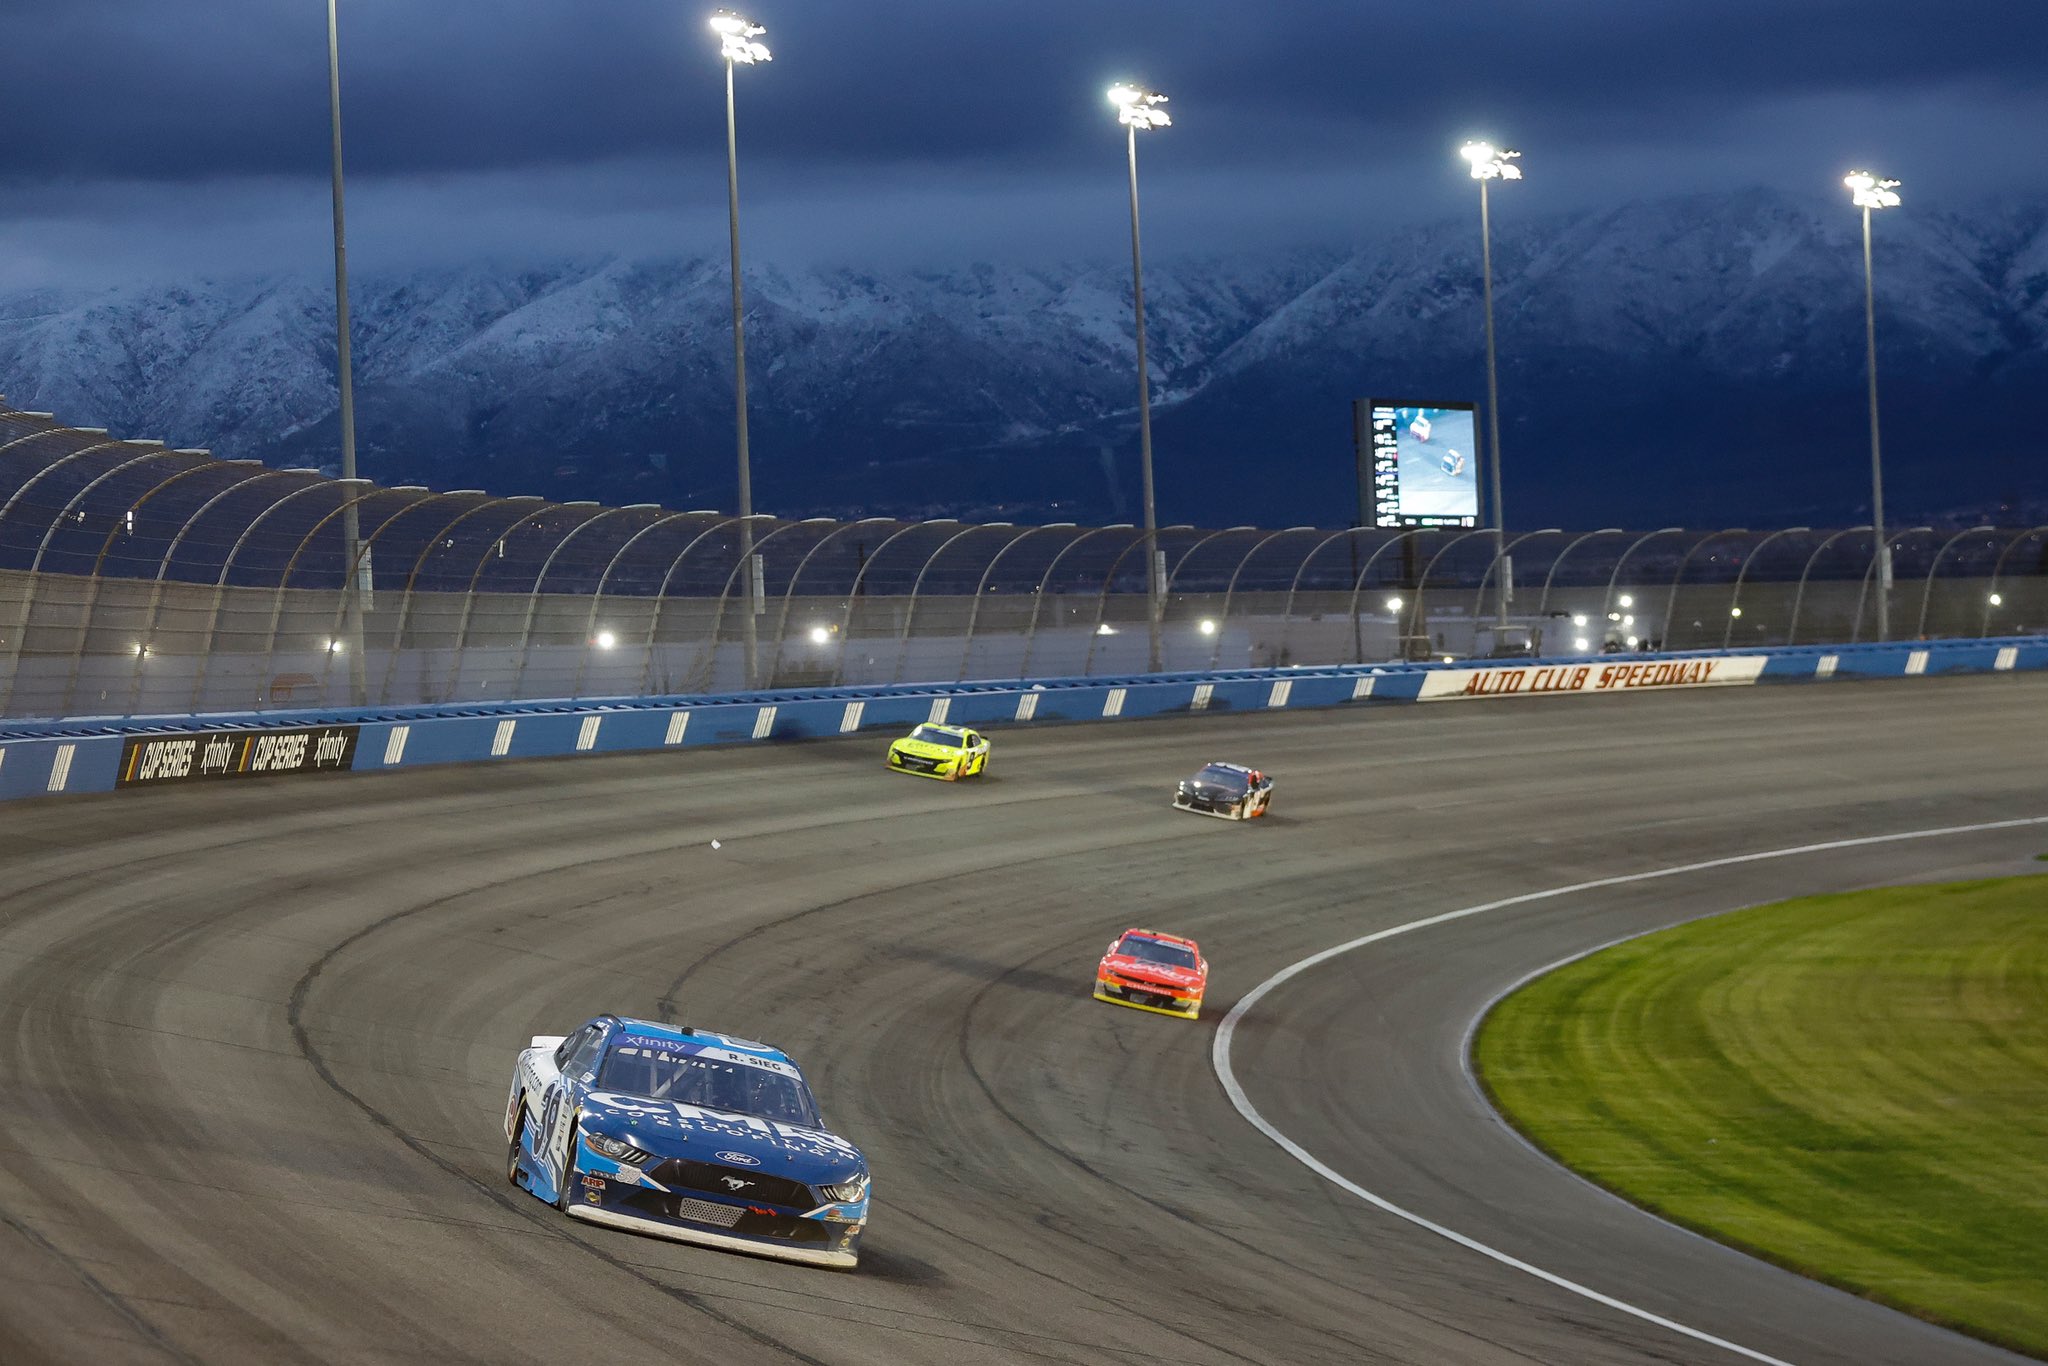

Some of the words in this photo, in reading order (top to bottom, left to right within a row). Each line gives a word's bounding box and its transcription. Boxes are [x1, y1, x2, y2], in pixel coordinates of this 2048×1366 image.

[1463, 670, 1525, 695] AUTO
[1529, 667, 1590, 692] CLUB
[1595, 660, 1718, 688] SPEEDWAY
[139, 742, 164, 780] CUP
[158, 740, 197, 778] SERIES
[201, 734, 234, 775] xfinity
[251, 736, 276, 771] CUP
[270, 734, 309, 770] SERIES
[314, 729, 348, 768] xfinity
[626, 1036, 685, 1052] xfinity
[728, 1053, 744, 1062] R.
[749, 1057, 781, 1071] SIEG
[533, 1081, 564, 1163] 39
[587, 1092, 860, 1158] CMR
[605, 1109, 854, 1160] CONSTRUCTION
[723, 1152, 752, 1164] Ford
[582, 1176, 604, 1187] ARP
